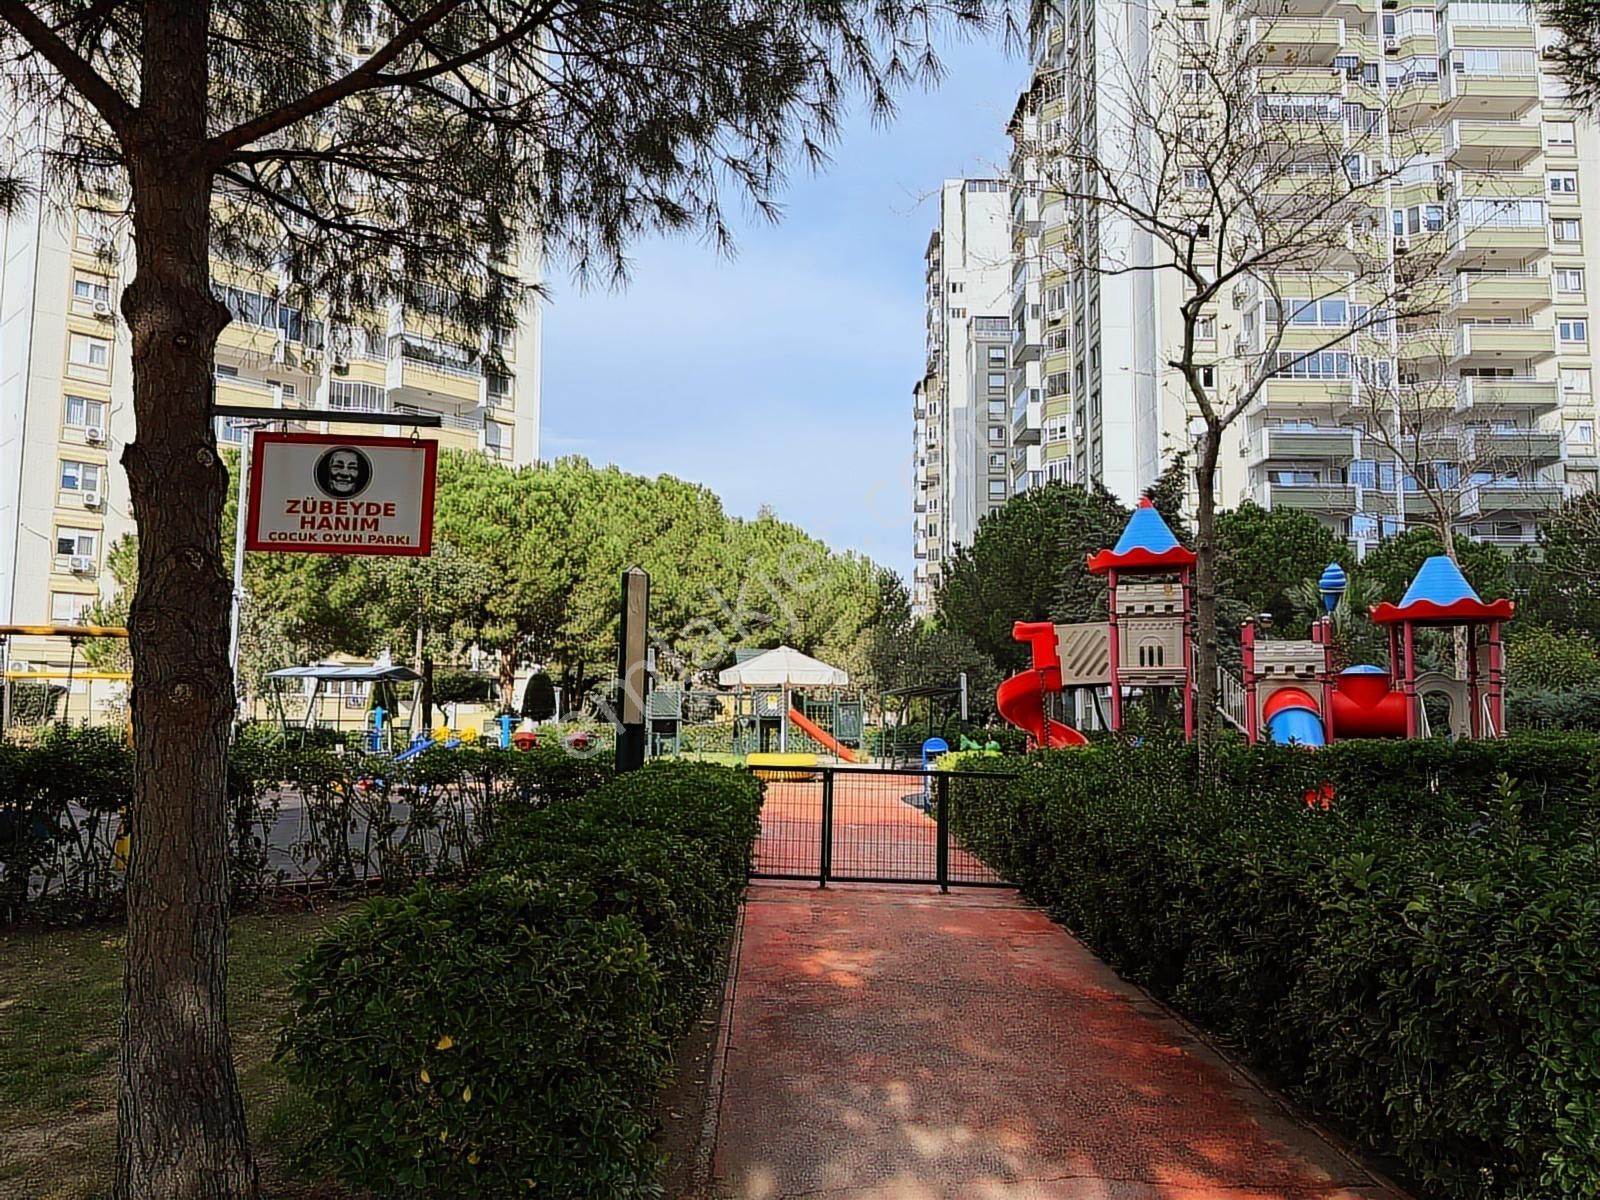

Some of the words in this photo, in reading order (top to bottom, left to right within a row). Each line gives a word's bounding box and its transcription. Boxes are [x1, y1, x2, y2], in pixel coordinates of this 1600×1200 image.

[286, 496, 396, 517] ZÜBEYDE
[300, 516, 380, 532] HANIM
[322, 533, 363, 544] OYUN
[367, 534, 410, 545] PARKI
